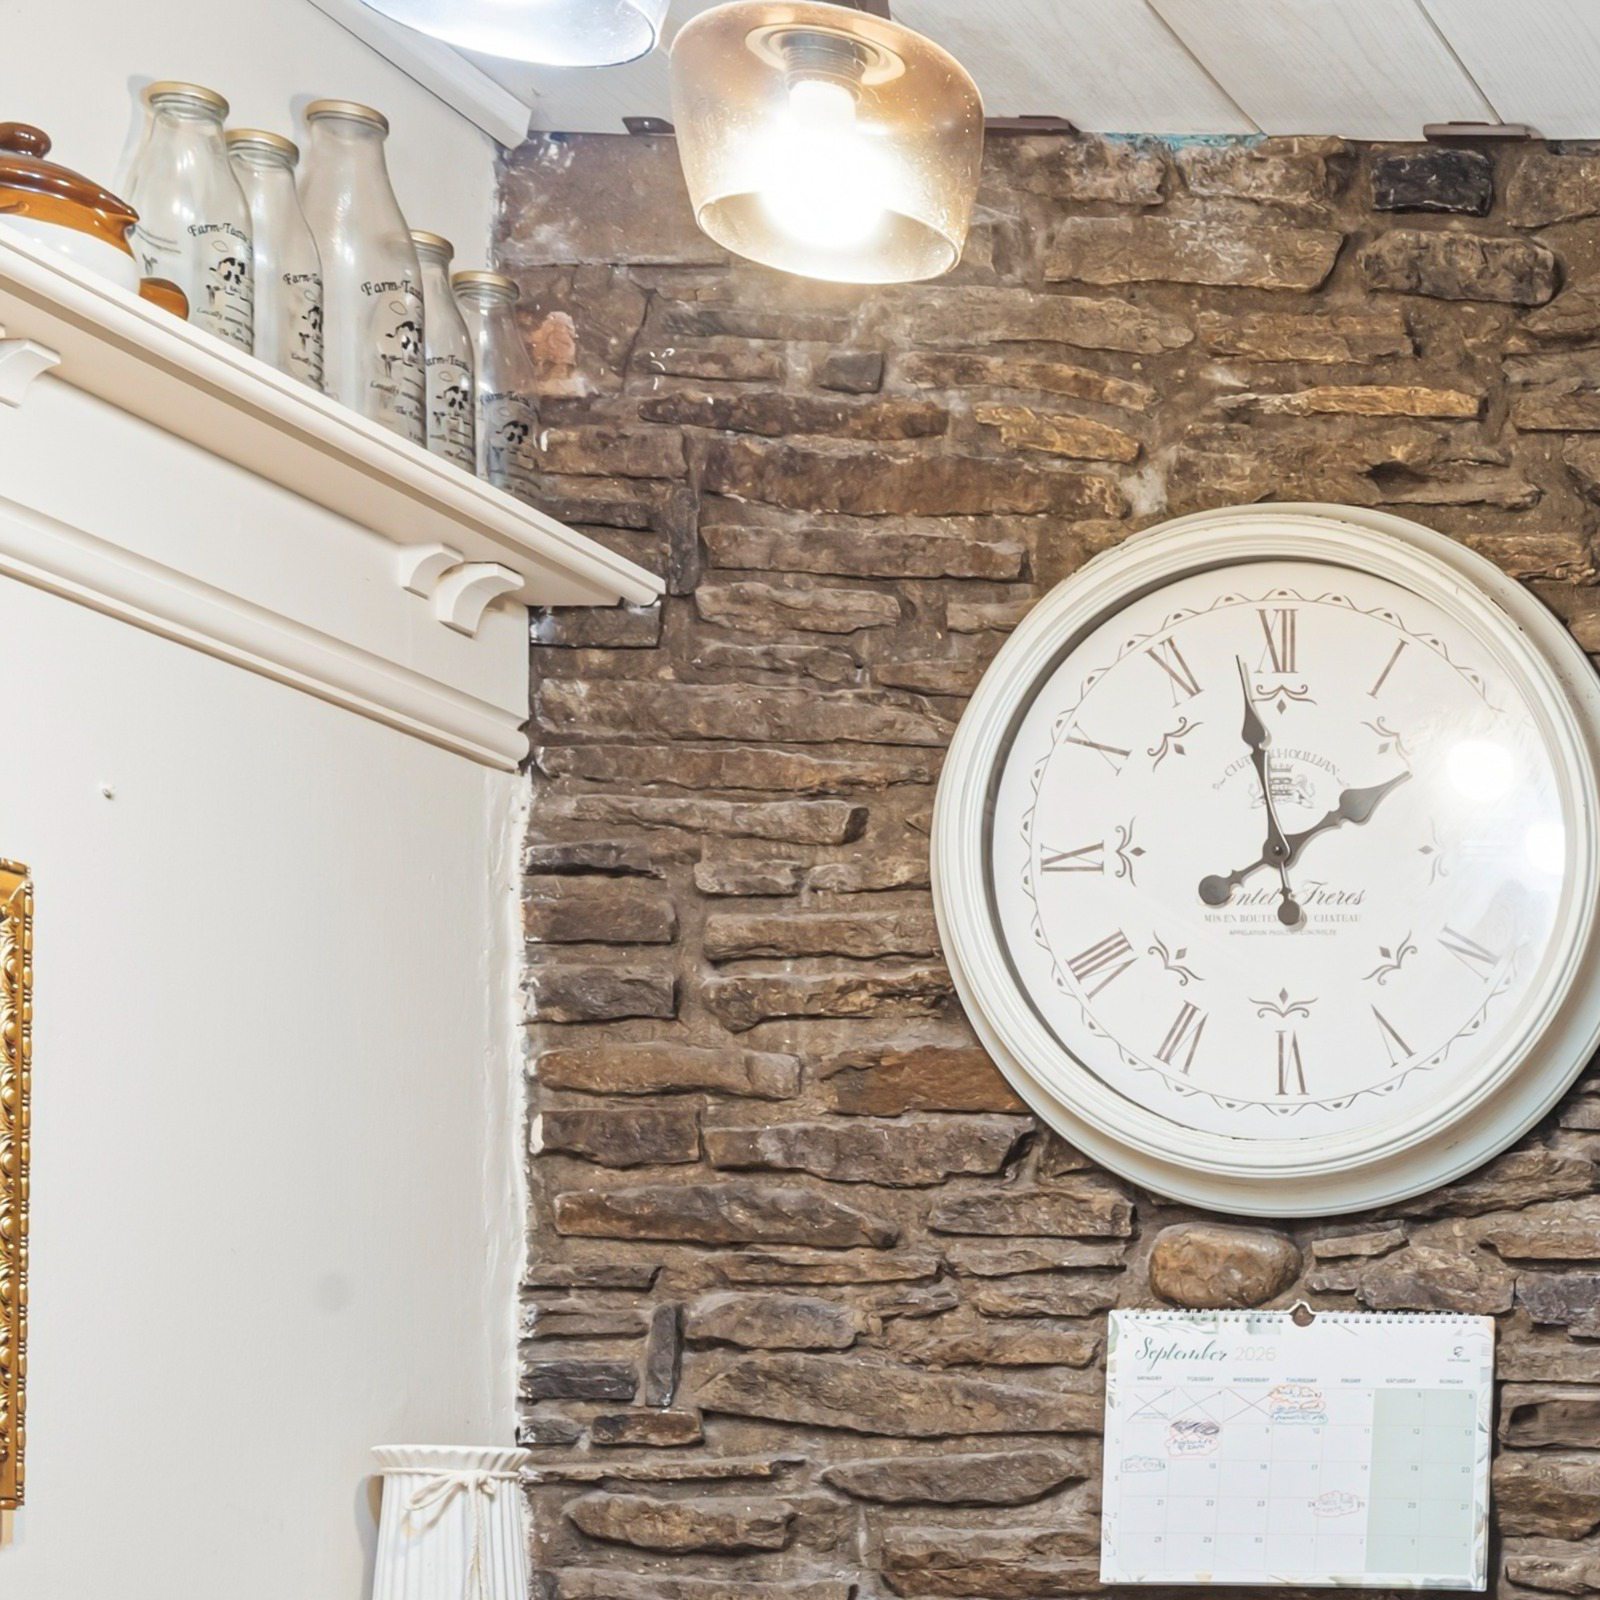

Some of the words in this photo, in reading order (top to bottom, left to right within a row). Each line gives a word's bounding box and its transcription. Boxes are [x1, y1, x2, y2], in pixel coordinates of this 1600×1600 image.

[1255, 609, 1299, 673] XII
[1135, 1337, 1227, 1372] September
[1234, 1346, 1277, 1362] 2026
